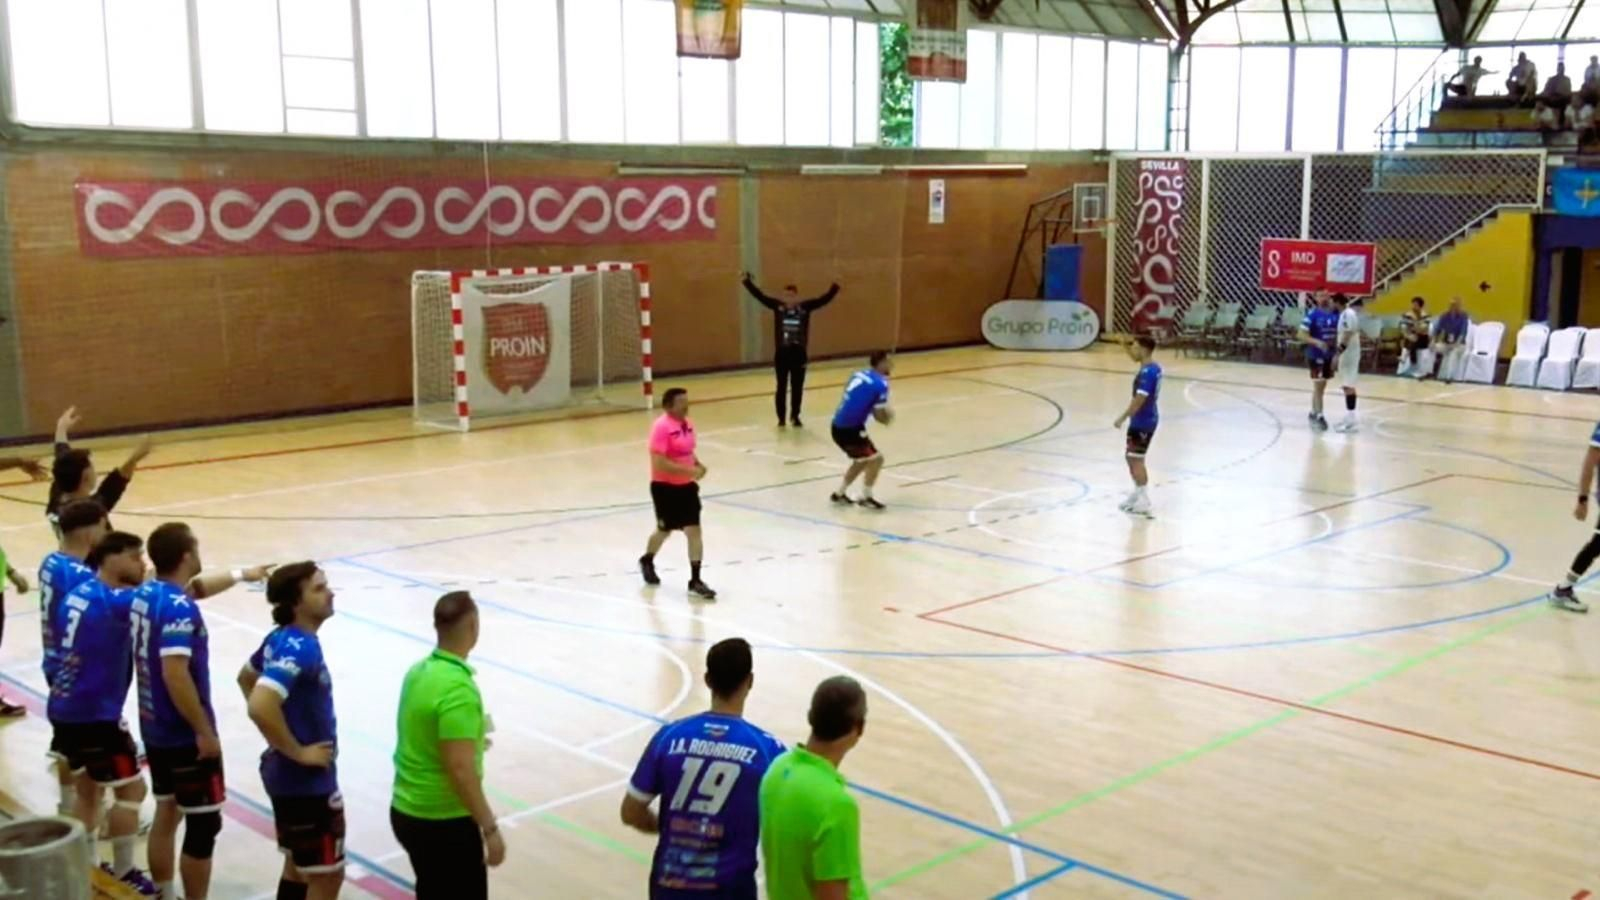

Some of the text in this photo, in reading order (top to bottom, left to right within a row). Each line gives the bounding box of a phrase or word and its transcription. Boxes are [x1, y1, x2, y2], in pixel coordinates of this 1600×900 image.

[1140, 160, 1180, 171] SEVILLA
[1291, 251, 1316, 265] IMD
[988, 316, 1094, 336] Grupo Proin
[490, 335, 546, 357] PROIN
[61, 607, 82, 649] 3
[688, 737, 758, 764] RODRIGUEZ
[669, 756, 742, 816] 19
